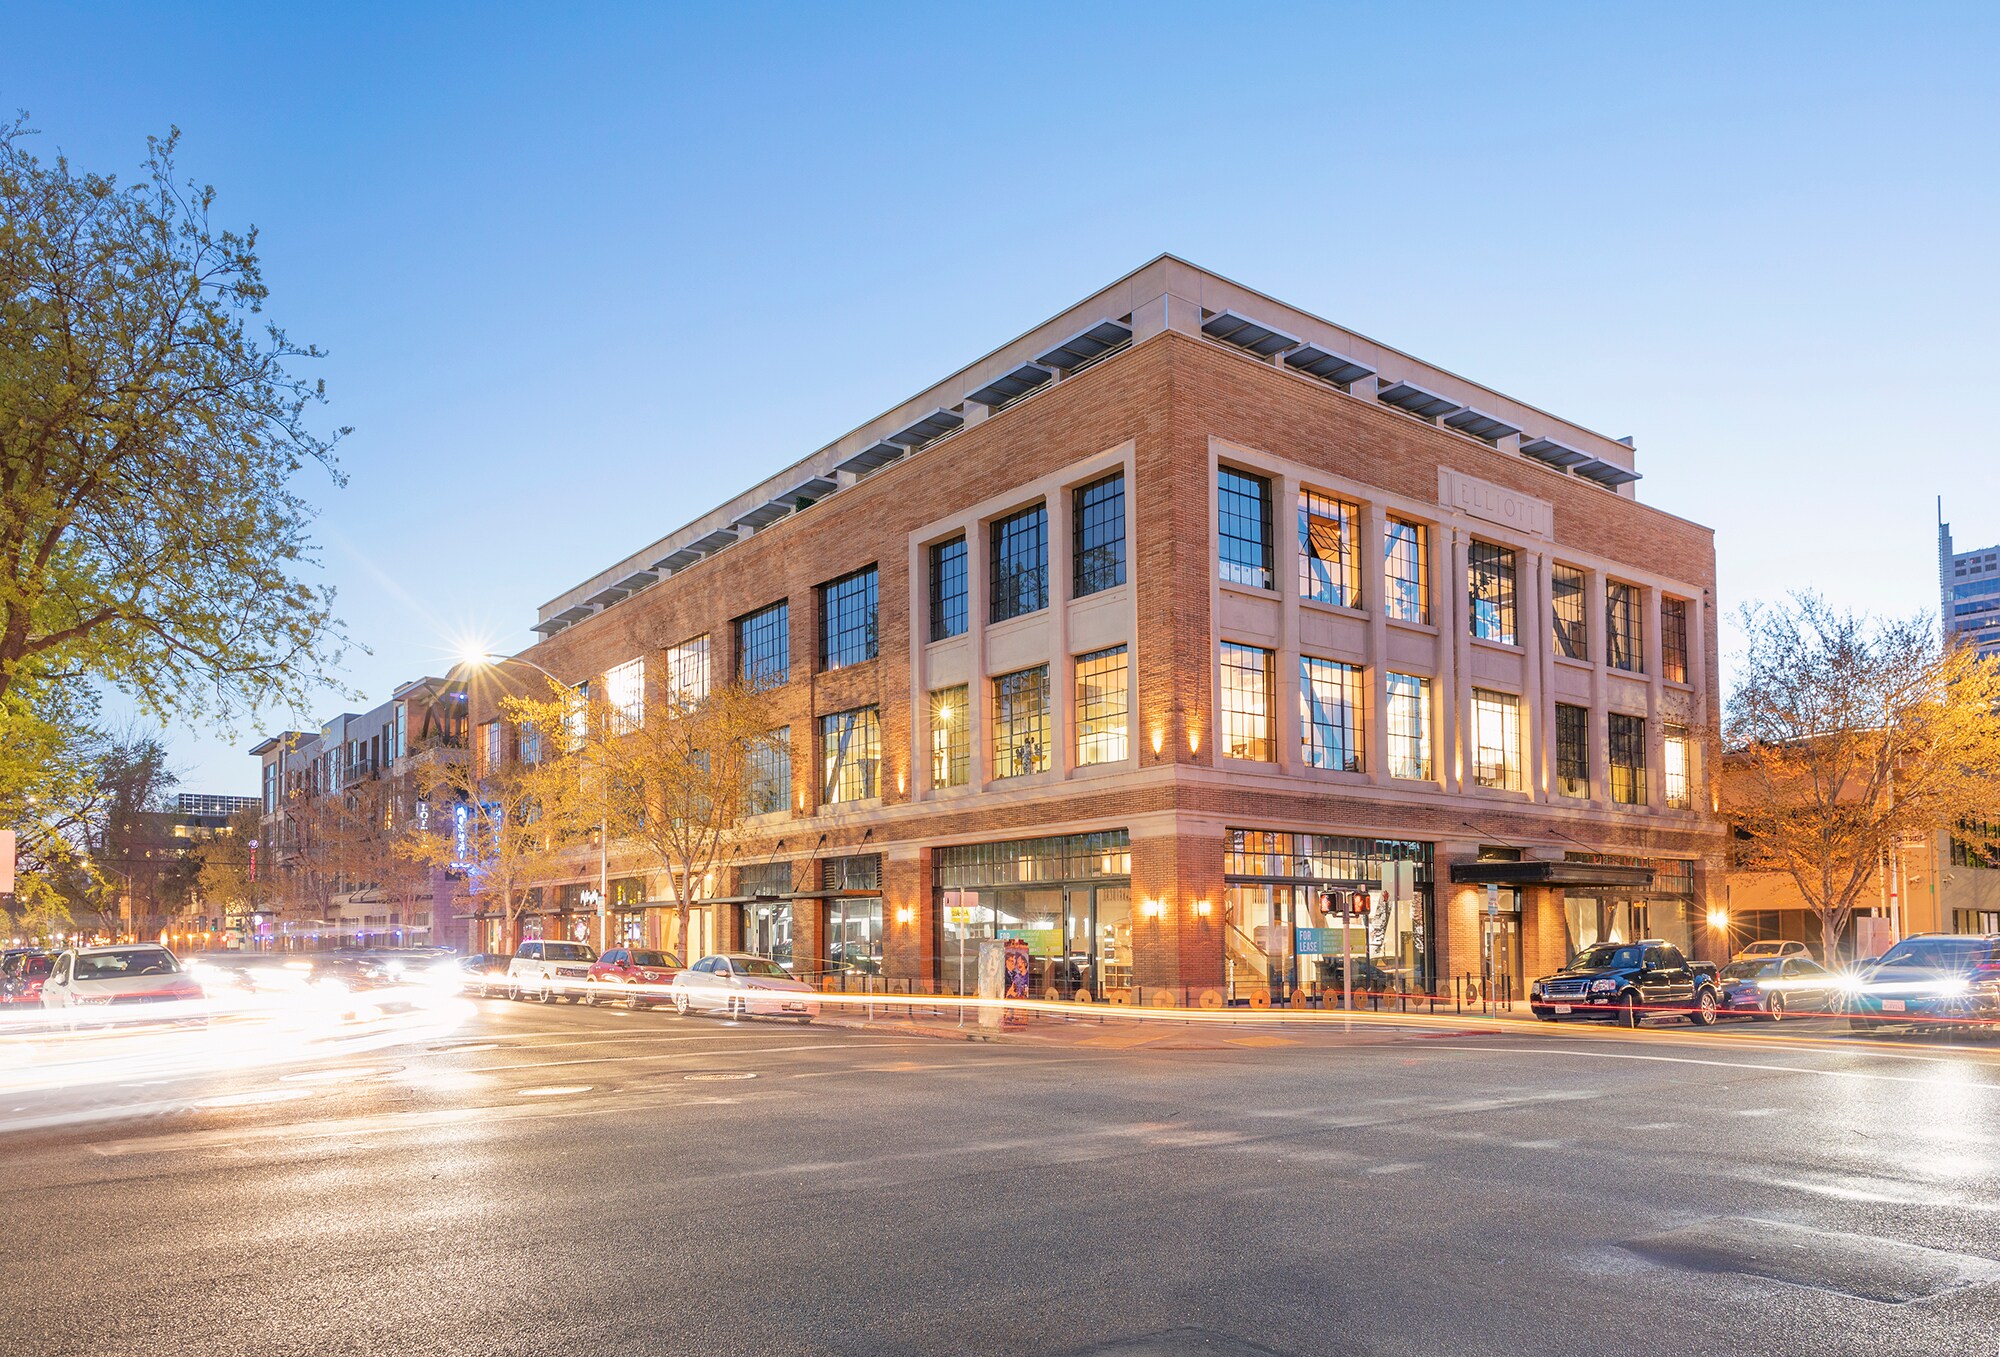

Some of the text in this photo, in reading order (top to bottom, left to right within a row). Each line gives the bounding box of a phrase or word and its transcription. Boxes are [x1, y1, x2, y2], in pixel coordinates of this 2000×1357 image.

[1462, 484, 1534, 525] ELLIOTT
[1299, 930, 1312, 941] FOR
[1299, 941, 1318, 952] LEASE
